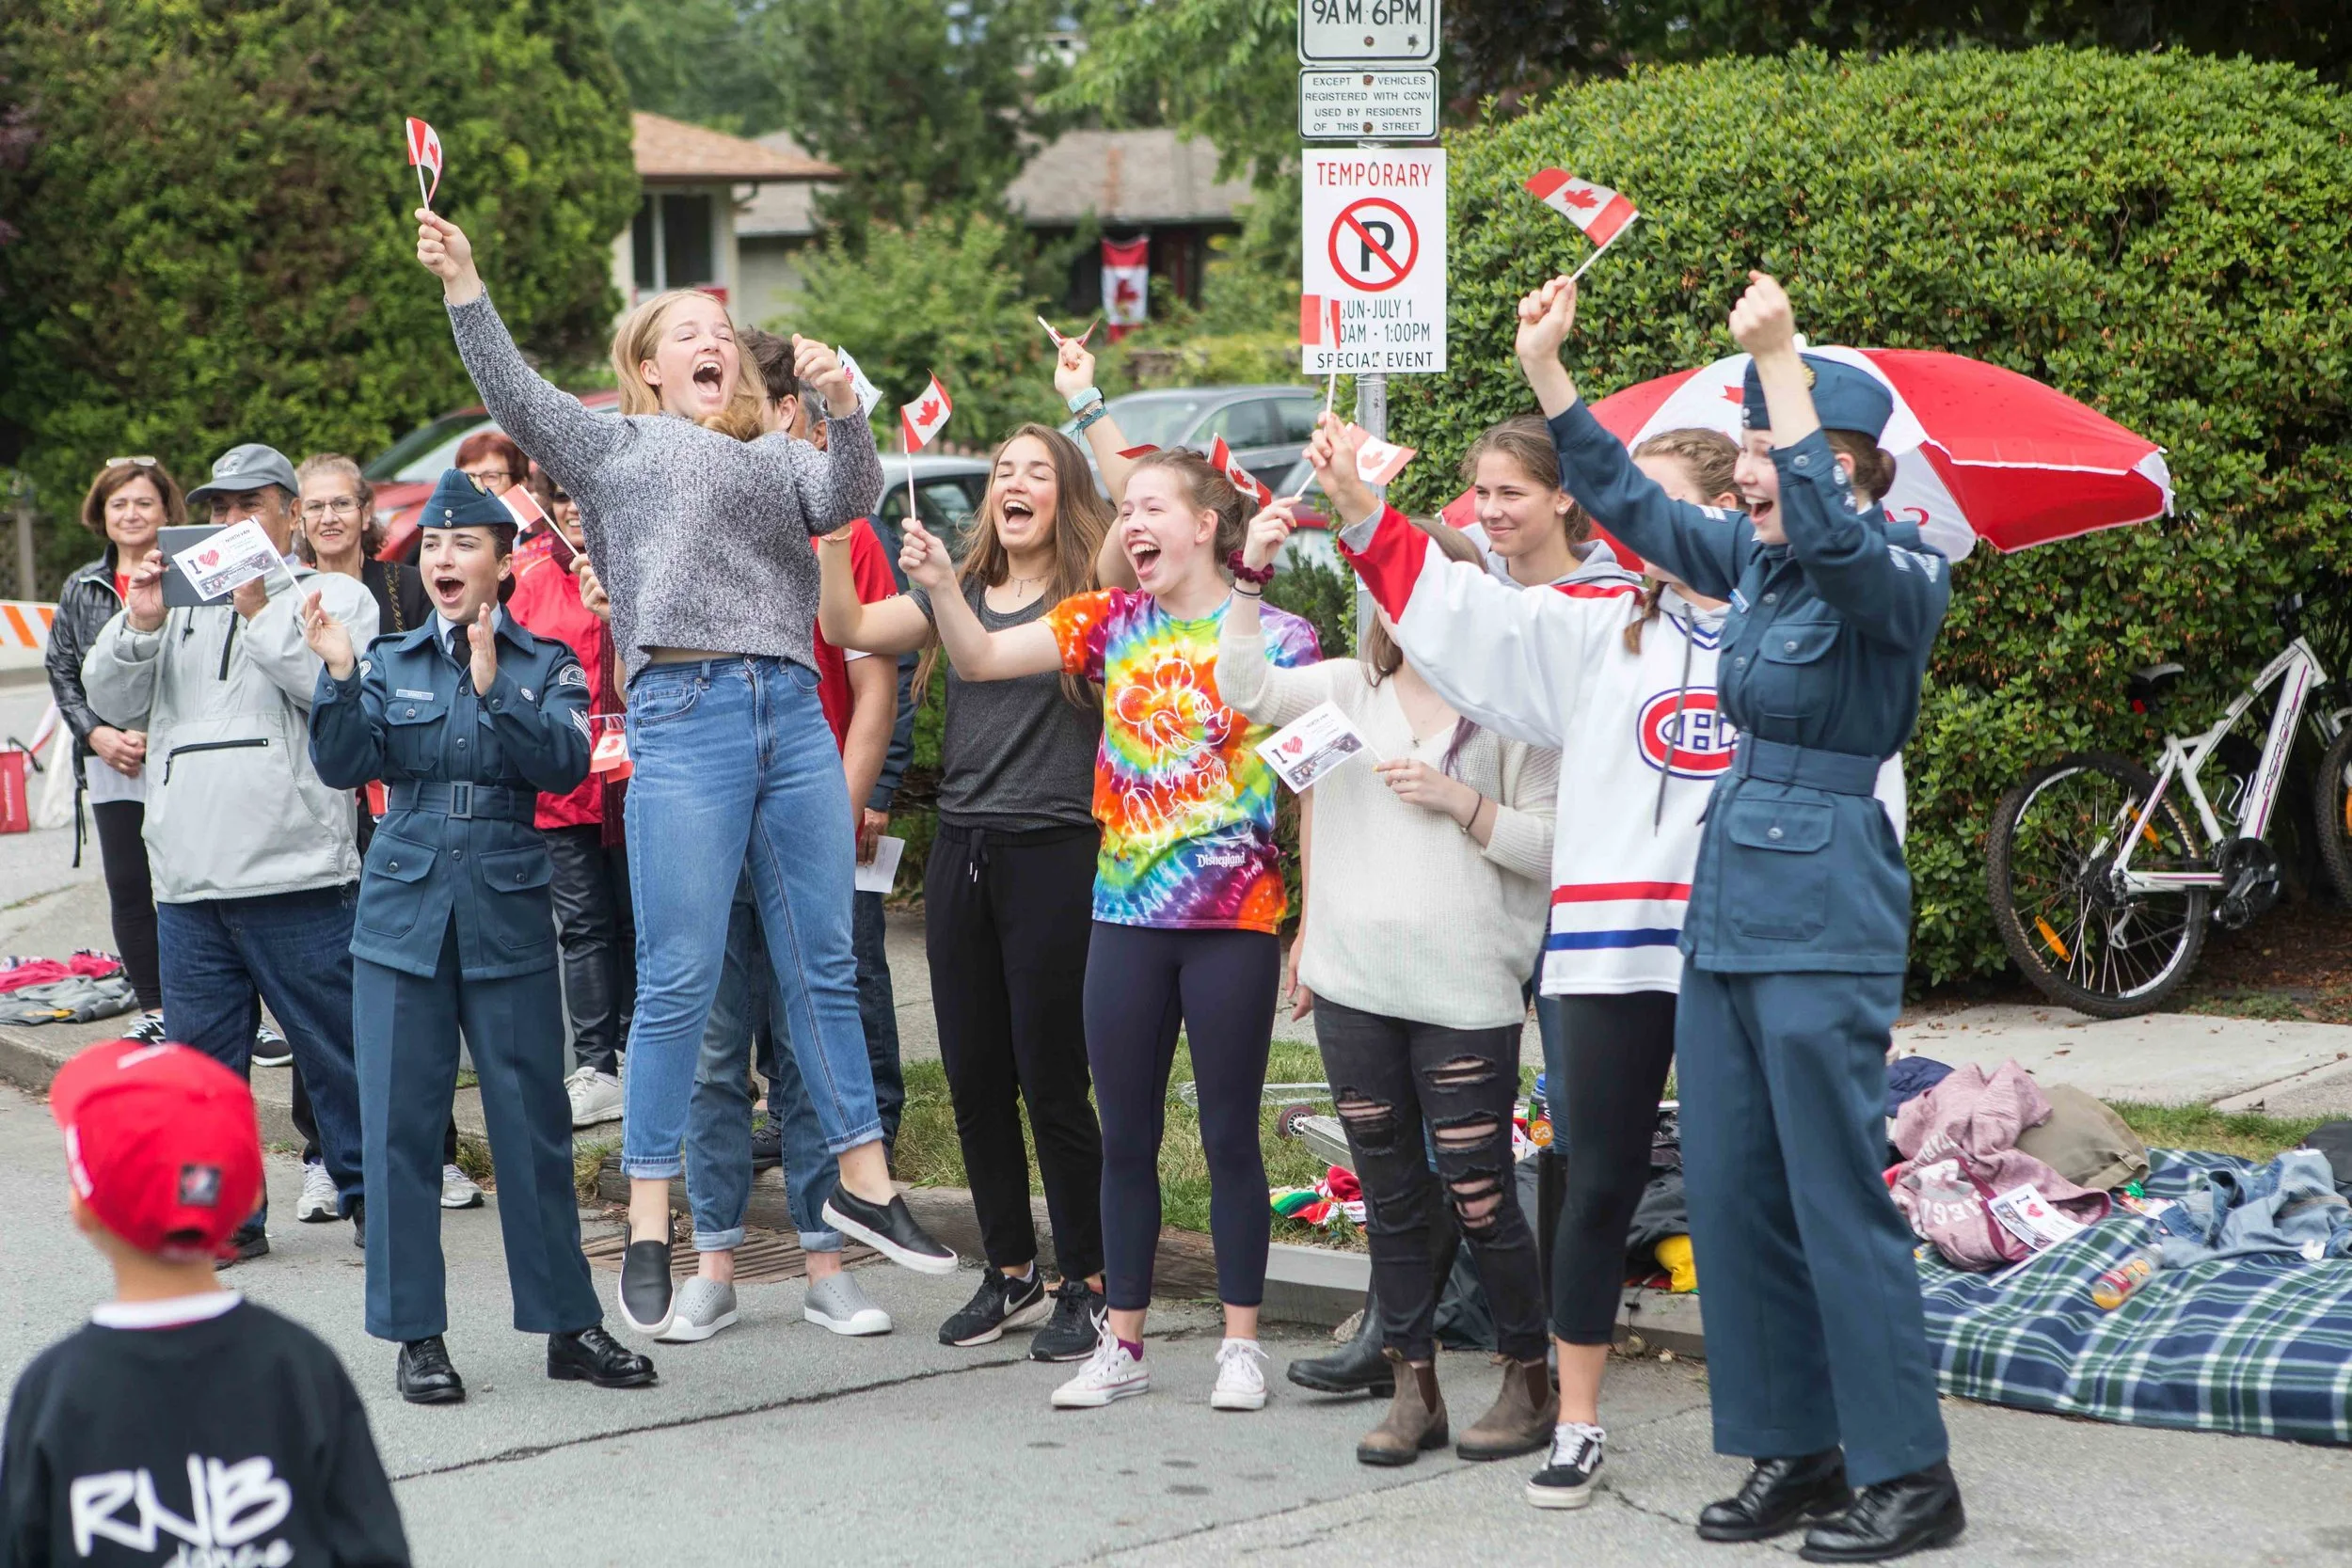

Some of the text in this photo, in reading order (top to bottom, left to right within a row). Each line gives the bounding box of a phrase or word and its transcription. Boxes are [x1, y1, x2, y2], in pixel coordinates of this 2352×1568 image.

[1312, 76, 1426, 87] EXCEPT VEHICLES
[1305, 92, 1368, 102] REGISTERED
[1374, 92, 1398, 101] WITH
[1314, 107, 1422, 117] USED BY RESIDENTS
[1313, 122, 1421, 132] OF THIS STREET
[1317, 162, 1433, 187] TEMPORARY
[1385, 323, 1431, 342] 1:00PM
[1317, 351, 1434, 369] SPECIAL EVENT
[1195, 851, 1247, 868] Disneyland
